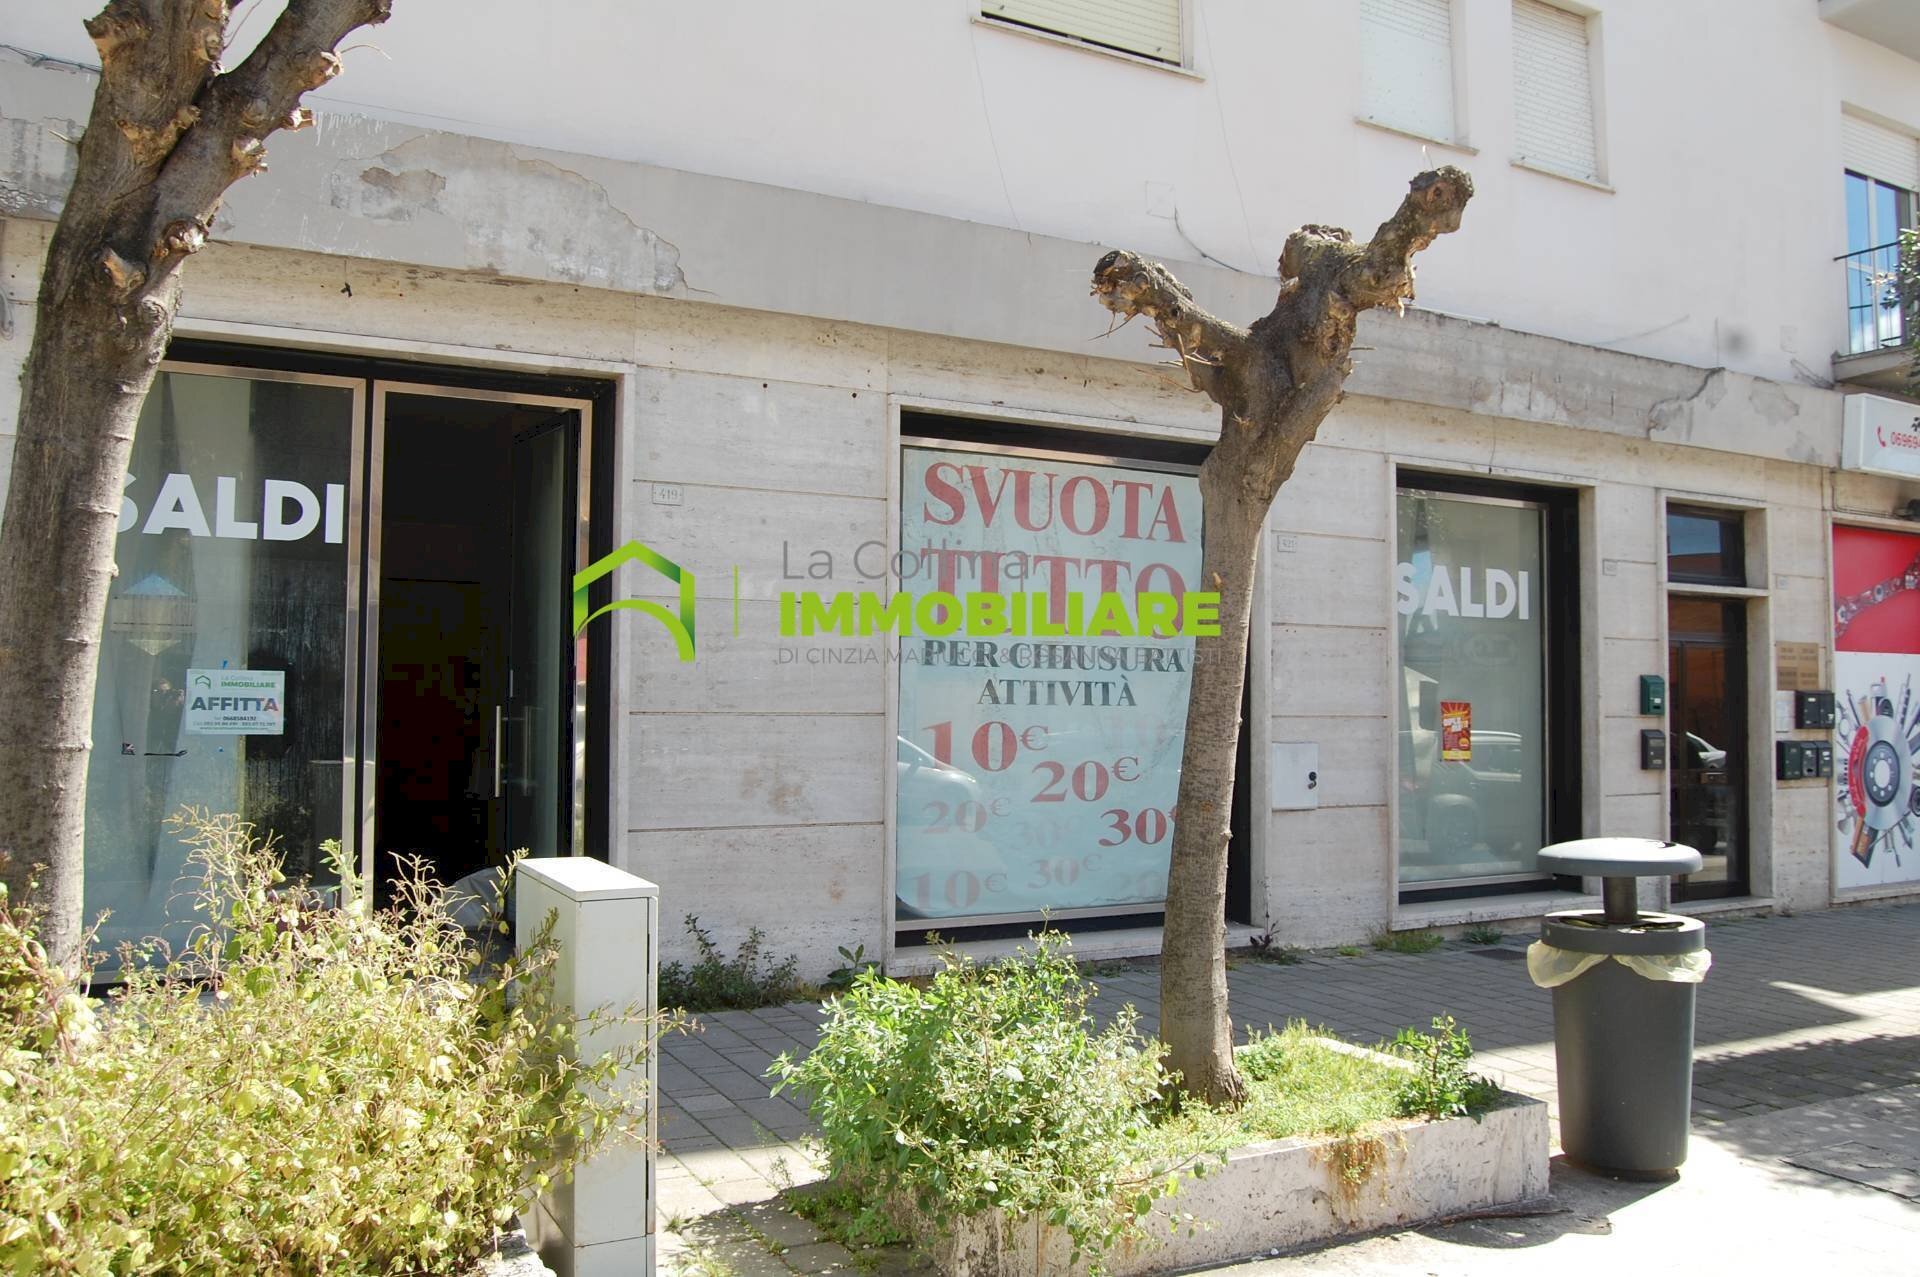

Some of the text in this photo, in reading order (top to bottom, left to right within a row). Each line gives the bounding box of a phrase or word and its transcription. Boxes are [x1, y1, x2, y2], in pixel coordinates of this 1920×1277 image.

[924, 462, 1187, 543] SVUOTA
[1396, 562, 1529, 620] SALDI
[921, 639, 1186, 673] PER CHIUSURA
[191, 696, 279, 711] AFFITTA
[977, 675, 1137, 707] ATTIVITÀ
[1030, 756, 1140, 803] 20€
